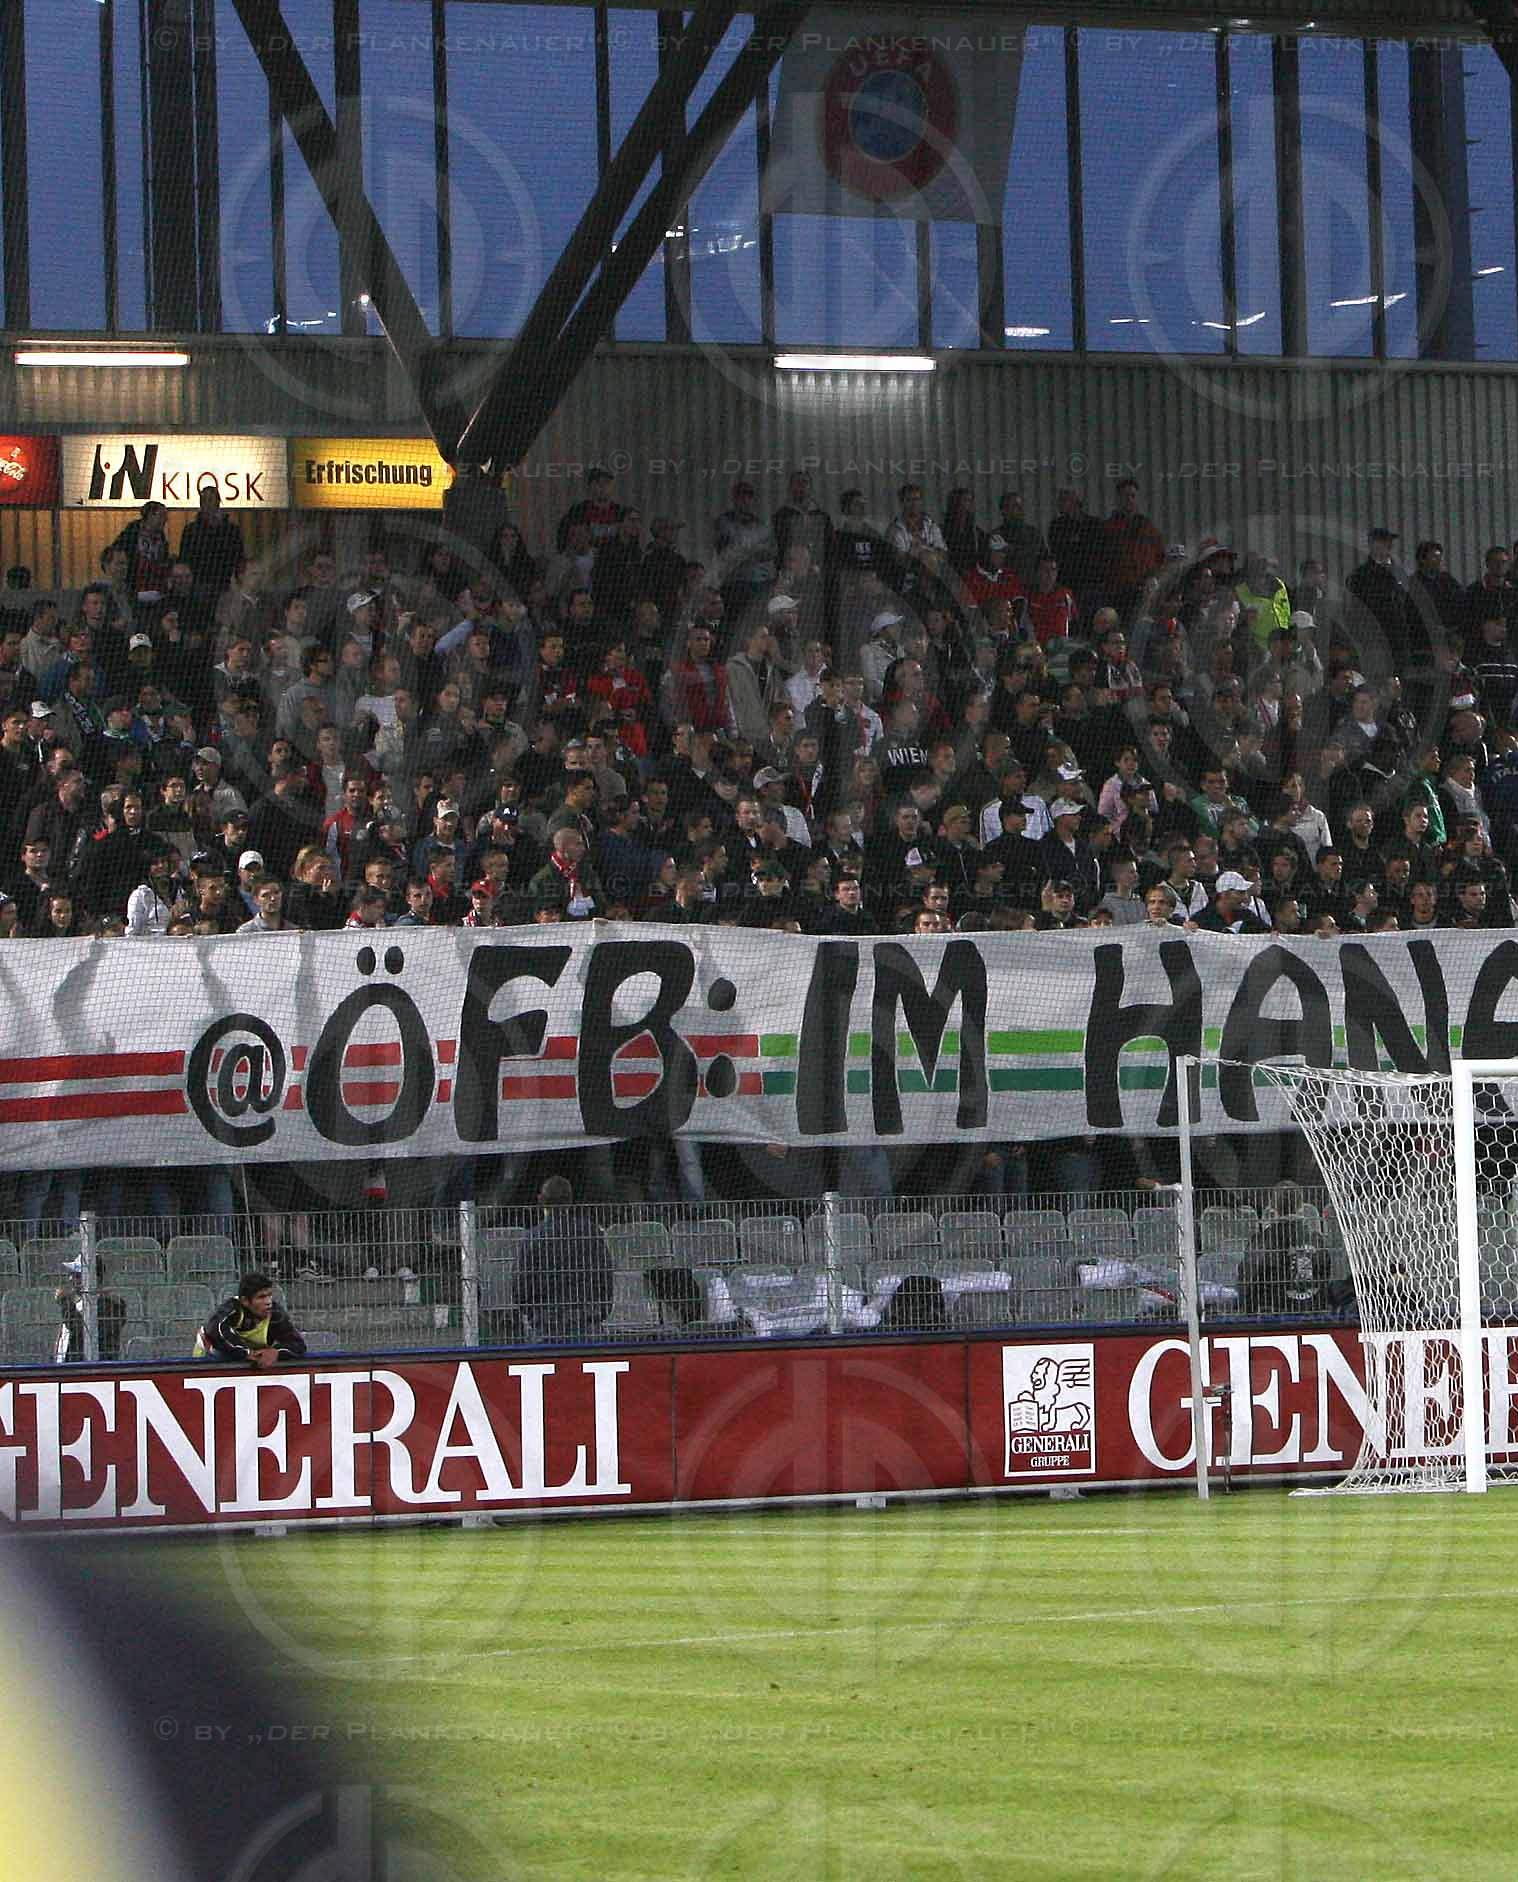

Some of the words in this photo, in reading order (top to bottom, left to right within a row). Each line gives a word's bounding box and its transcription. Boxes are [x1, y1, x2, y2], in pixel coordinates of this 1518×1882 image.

[305, 460, 433, 488] Erfrischung
[162, 472, 265, 501] KIOSK
[887, 747, 928, 767] WIEN
[795, 938, 991, 1136] IM
[1010, 1434, 1090, 1454] GENERALI
[1030, 1455, 1070, 1468] GRUPPE
